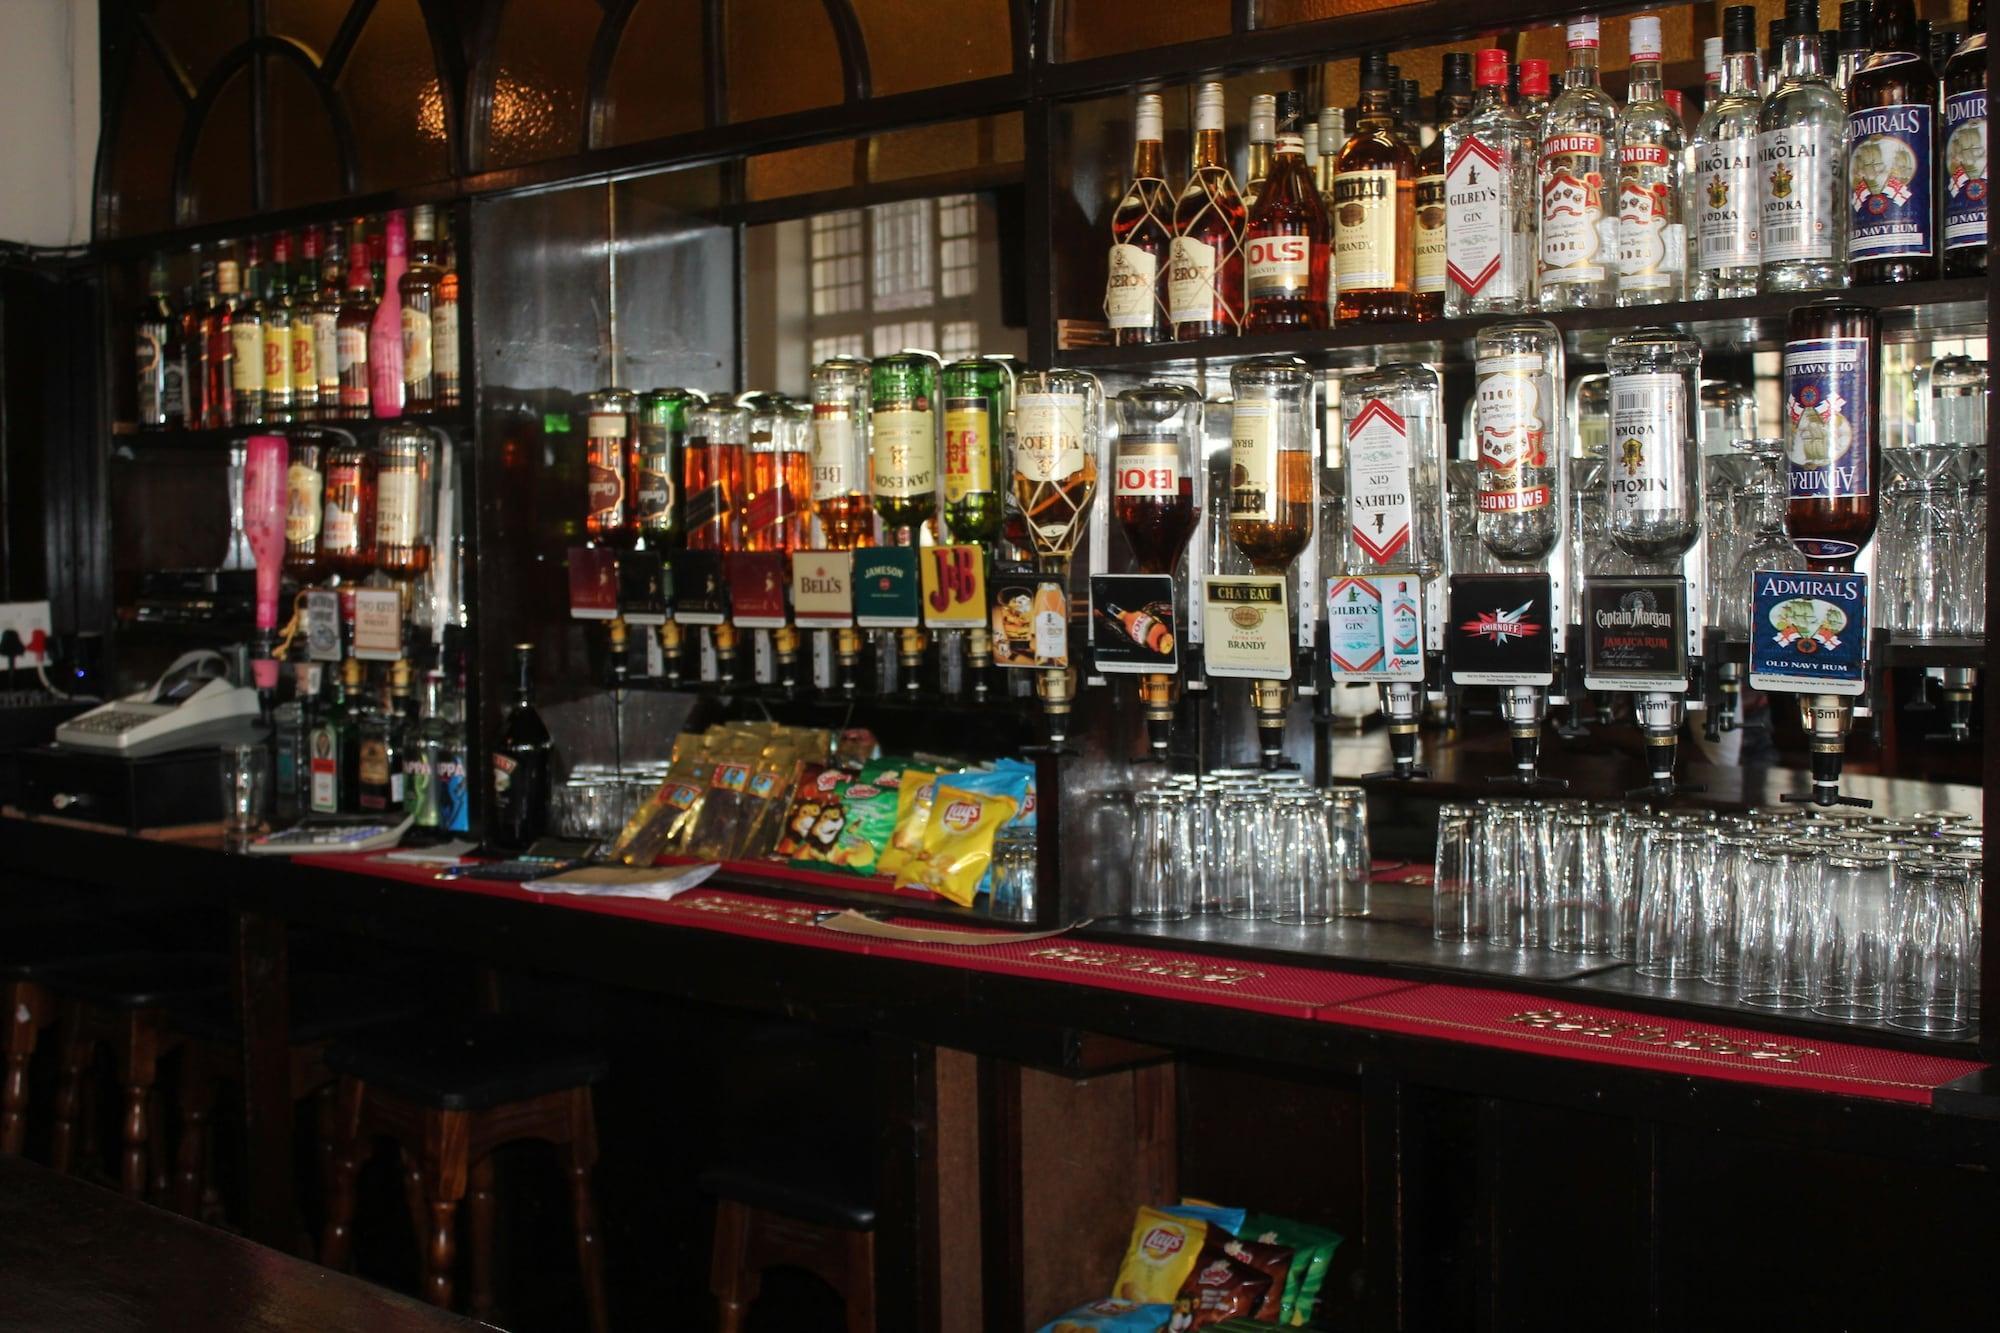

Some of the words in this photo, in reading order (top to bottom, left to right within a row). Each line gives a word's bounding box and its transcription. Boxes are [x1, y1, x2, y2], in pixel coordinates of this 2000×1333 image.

[1620, 148, 1662, 163] RNOFF
[1449, 187, 1497, 207] GILBEY'S
[1764, 200, 1803, 213] VODKA
[1463, 213, 1482, 223] GIN
[1702, 210, 1739, 223] VODKA
[1863, 225, 1890, 237] NAVY
[1891, 222, 1918, 234] RUM
[1249, 241, 1305, 266] OLS
[1800, 363, 1828, 375] NAVY
[1614, 424, 1656, 437] VODKA
[1232, 439, 1254, 449] BRAN
[1368, 474, 1390, 486] GIN
[1611, 477, 1668, 494] NIKOLA
[1787, 466, 1858, 491] ADMIRAL
[1354, 493, 1406, 511] GILBEY'S
[1480, 490, 1543, 509] SMRNOFF
[864, 566, 905, 581] JAMESON
[929, 547, 976, 613] J&B
[1217, 586, 1272, 601] CHATEAU
[1761, 576, 1858, 601] ADMIRALS
[1331, 604, 1379, 616] GILBEY'S
[1596, 608, 1633, 629] Captain
[1632, 606, 1672, 630] Morgan
[1345, 622, 1365, 631] GIN
[1482, 622, 1520, 634] SMIRNOFF
[1227, 640, 1267, 650] BRANDY
[1603, 636, 1643, 649] JAMAICA
[1645, 637, 1670, 649] RUM
[1765, 659, 1789, 668] OLD
[1791, 661, 1819, 672] NAVY
[1822, 663, 1848, 672] RUM
